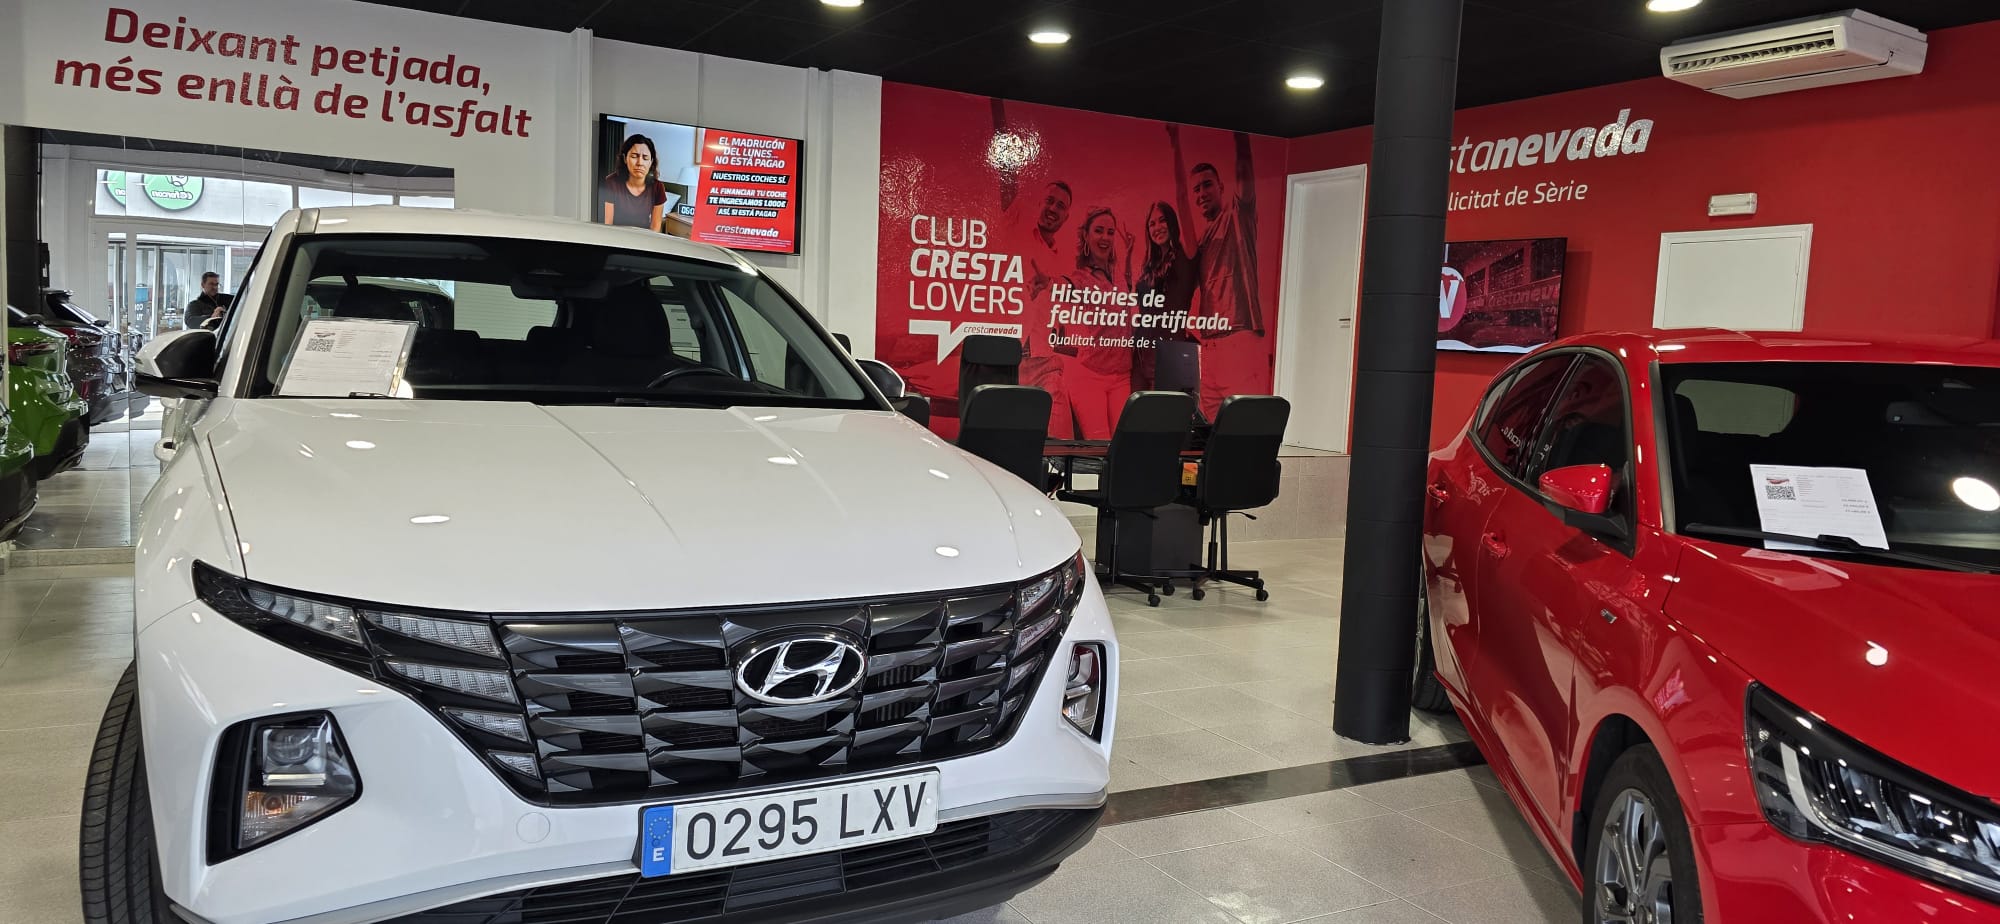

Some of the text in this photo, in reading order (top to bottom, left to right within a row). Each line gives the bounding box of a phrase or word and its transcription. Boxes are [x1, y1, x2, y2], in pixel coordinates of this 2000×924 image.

[104, 7, 490, 96] Deixant petjada,
[54, 55, 163, 95] més
[177, 71, 300, 111] enllà
[314, 83, 369, 119] de
[718, 136, 786, 150] EL MADRUGÓN
[723, 146, 742, 156] DEL
[714, 155, 785, 169] NO ESTÁ PAGAO
[712, 172, 750, 182] NUESTROS
[750, 174, 777, 184] COCHES
[720, 187, 756, 197] FINANCIAR
[1447, 180, 1588, 211] licitat de Sèrie
[708, 196, 719, 204] TE
[719, 197, 763, 207] INGRESAMOS
[715, 224, 779, 238] crestanevada
[910, 213, 987, 249] CLUB
[910, 248, 1024, 284] CRESTA
[909, 280, 1024, 315] LOVERS
[1050, 283, 1166, 308] Històries de
[1047, 304, 1233, 334] felicitat certificada.
[963, 325, 1018, 335] crestanevada
[1048, 333, 1096, 348] Qualitat,
[1099, 335, 1134, 348] també
[1136, 337, 1150, 348] de
[686, 781, 927, 861] 0295 LXV
[652, 847, 665, 862] E
